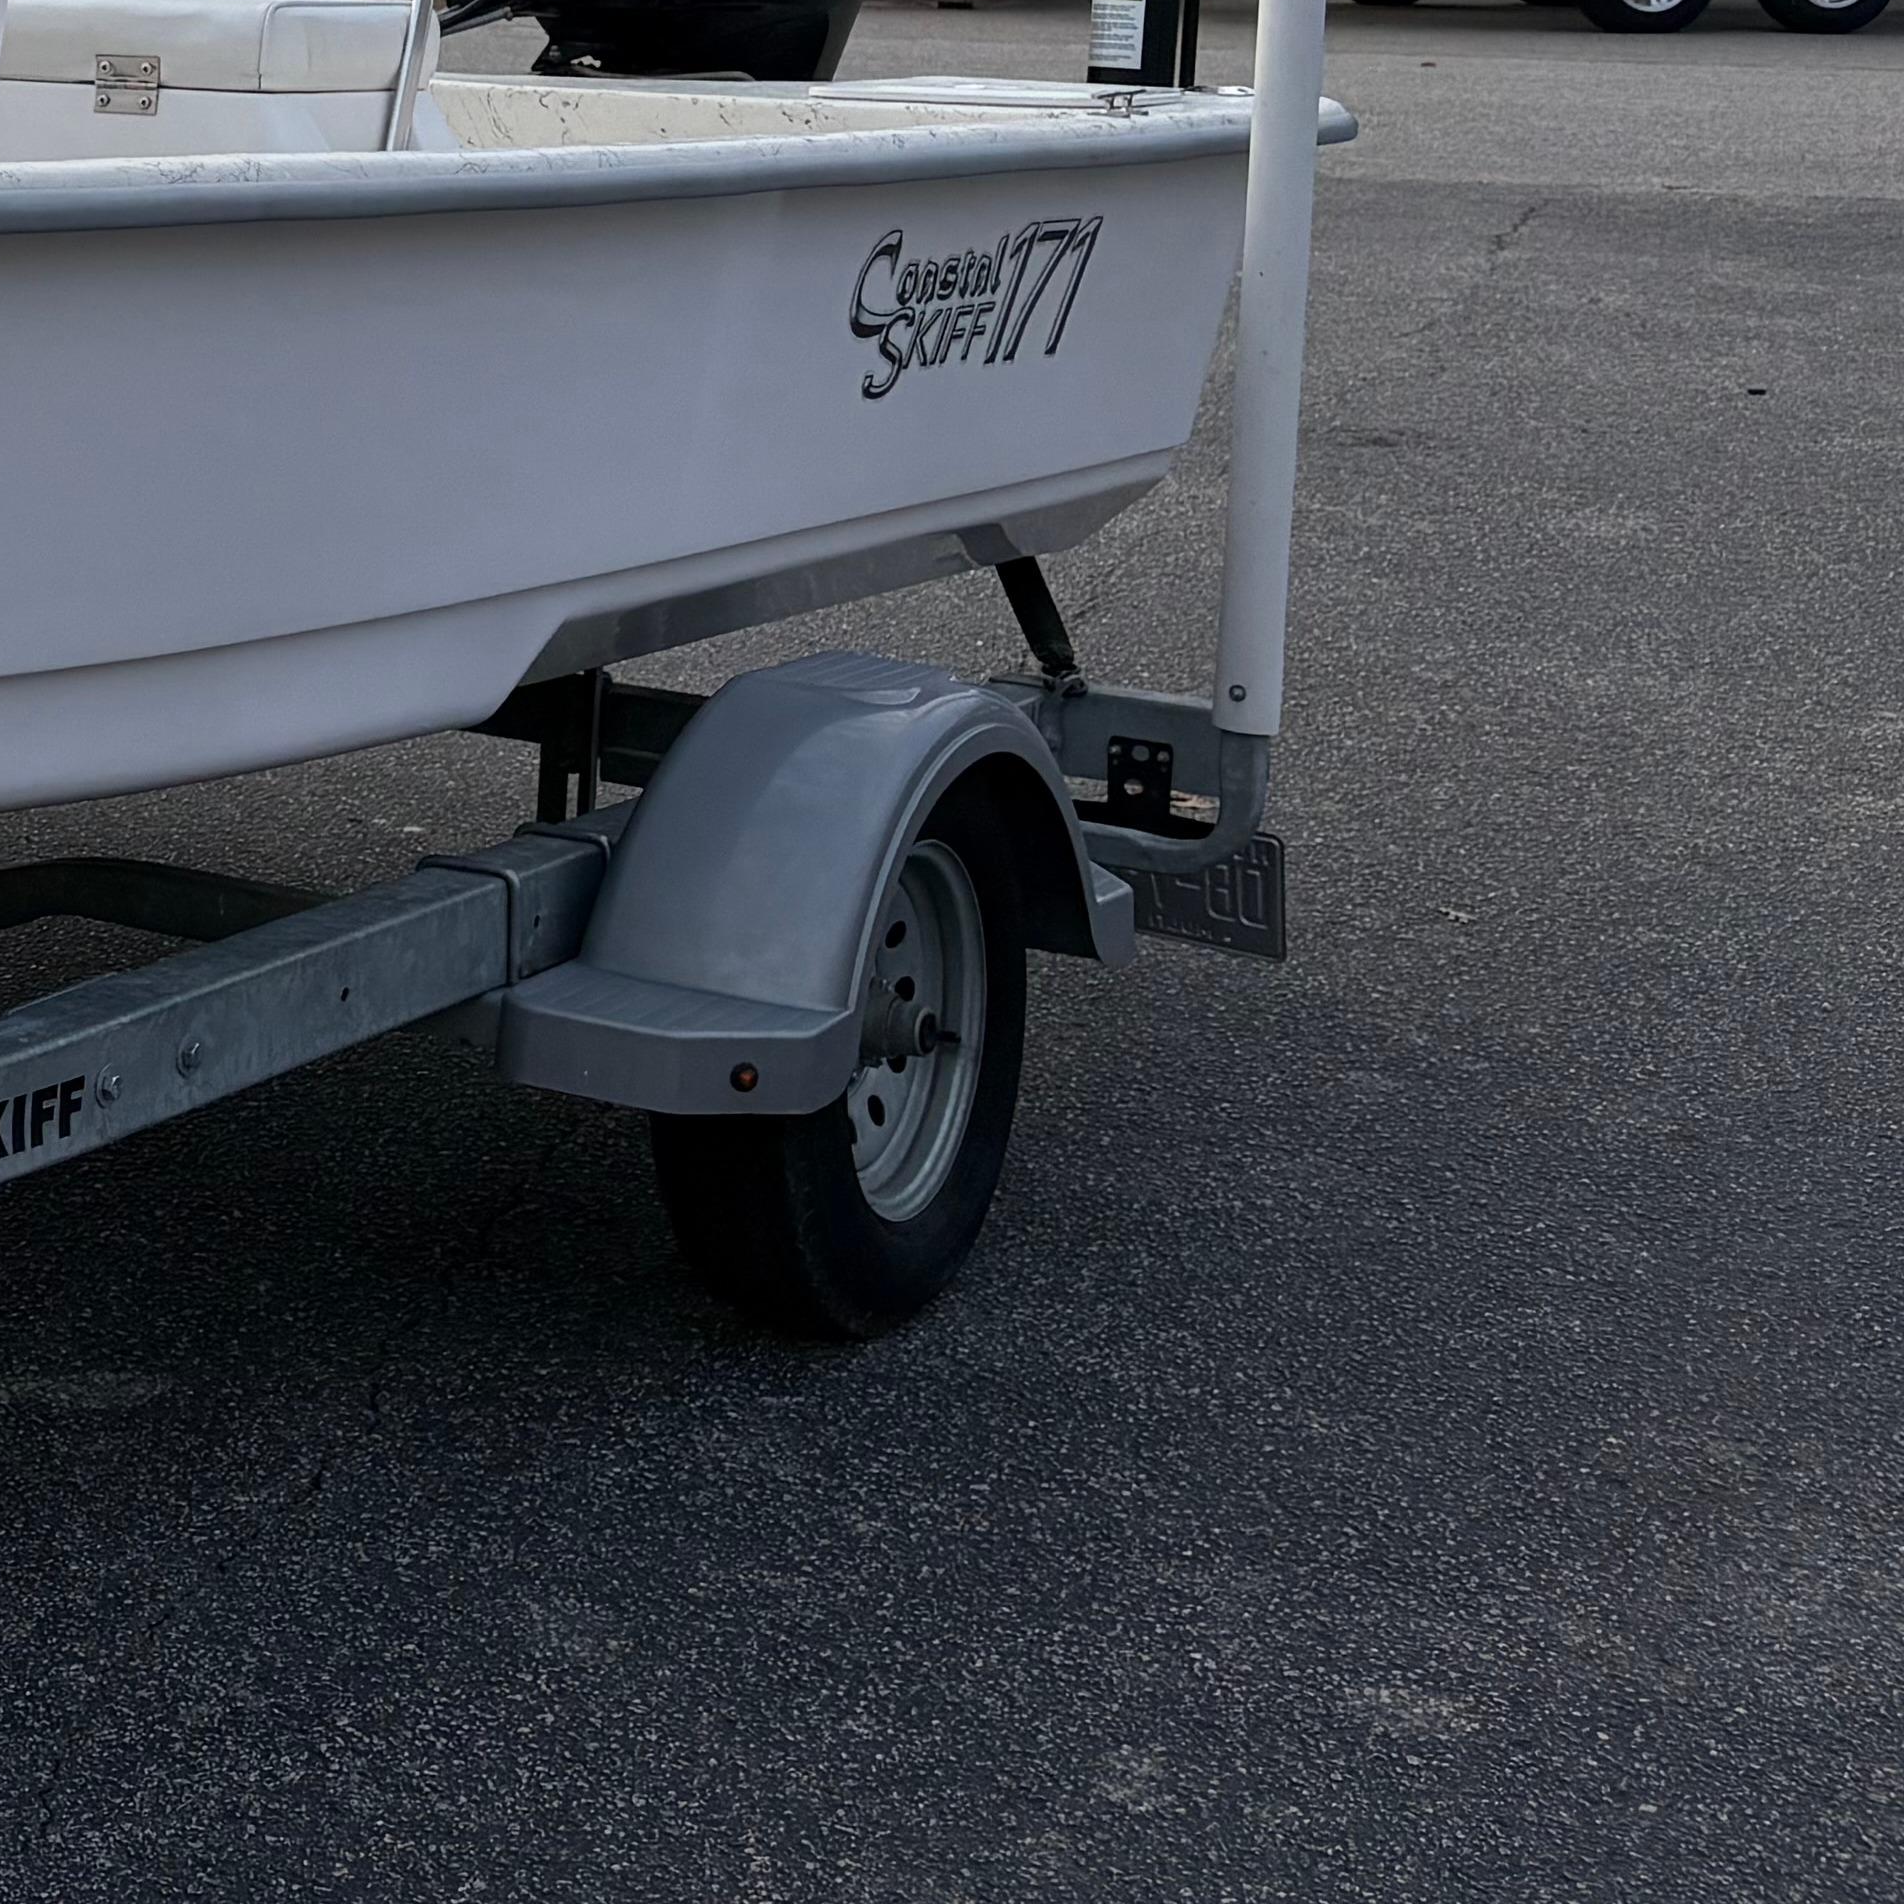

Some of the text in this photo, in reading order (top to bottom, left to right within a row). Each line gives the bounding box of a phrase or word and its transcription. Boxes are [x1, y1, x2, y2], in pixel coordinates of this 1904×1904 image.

[849, 216, 1103, 365] Coastal 171
[862, 301, 996, 399] SKIFF
